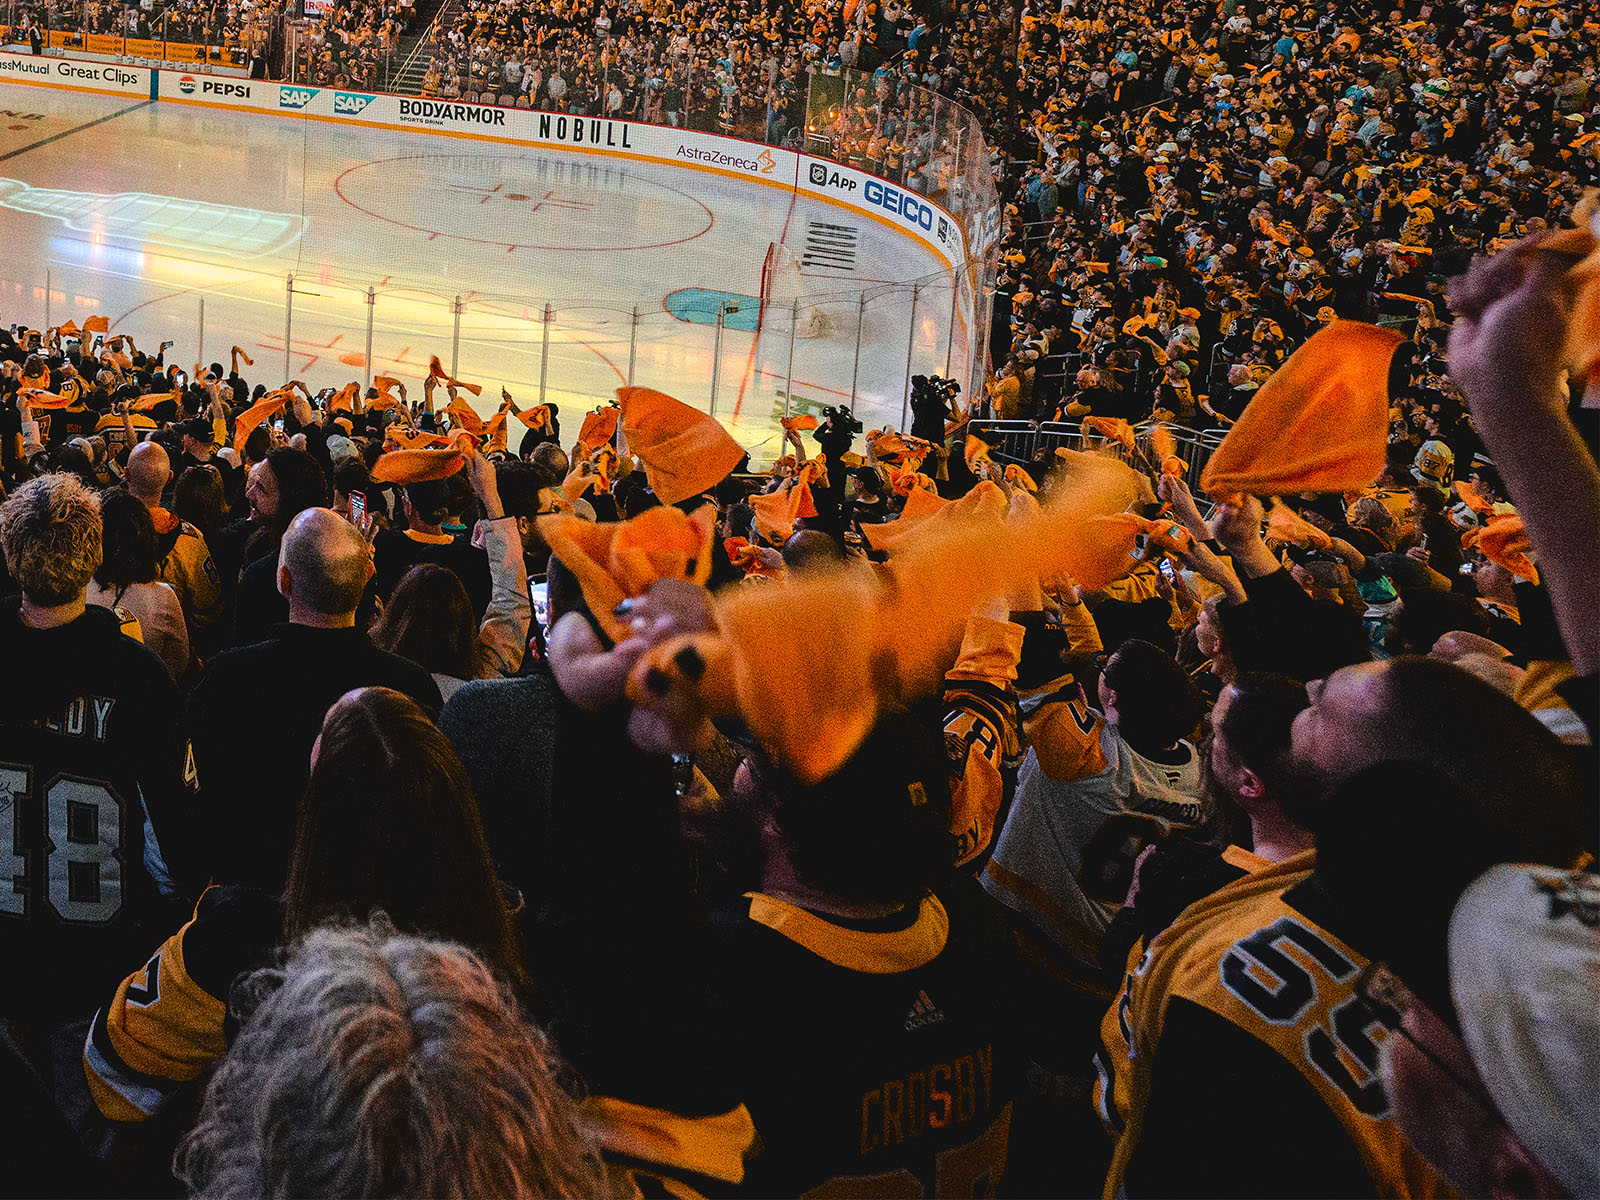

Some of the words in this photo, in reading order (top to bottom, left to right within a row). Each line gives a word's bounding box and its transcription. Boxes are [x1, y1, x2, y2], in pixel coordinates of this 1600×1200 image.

[58, 61, 100, 82] Great
[103, 66, 138, 87] Clips
[179, 81, 196, 89] PEPSI
[202, 80, 251, 98] PEPSI
[280, 88, 312, 105] SAP
[335, 94, 368, 112] SAP
[400, 99, 505, 126] BODYARMOR
[400, 115, 422, 123] SPORTS
[424, 118, 444, 126] DRINK
[538, 114, 632, 149] NOBULL
[676, 144, 759, 173] AstraZeneca
[864, 179, 934, 231] GEICO
[860, 1042, 994, 1156] CROSBY
